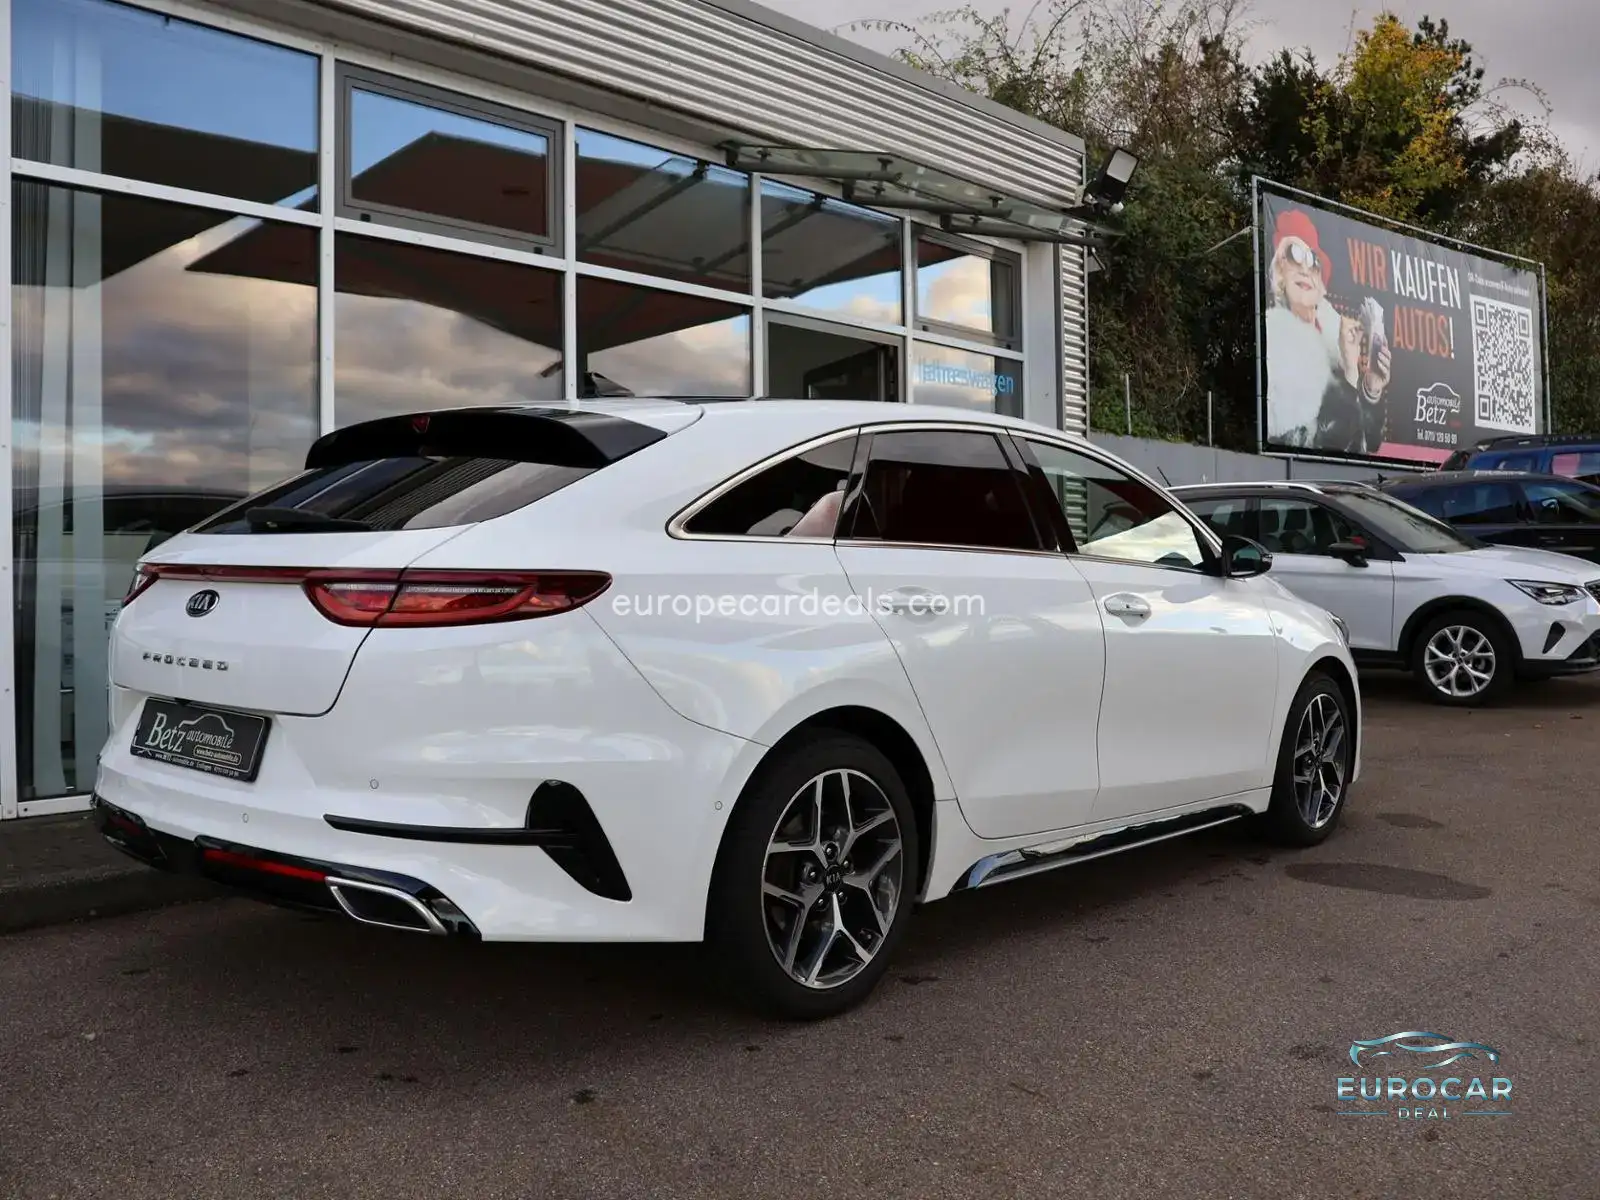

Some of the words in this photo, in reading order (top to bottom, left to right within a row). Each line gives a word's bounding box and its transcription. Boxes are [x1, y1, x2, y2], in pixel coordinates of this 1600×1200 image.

[1346, 237, 1388, 291] WIR
[1391, 250, 1461, 310] KAUFEN
[1393, 303, 1455, 360] AUTOS!
[1414, 395, 1446, 425] Betz
[142, 652, 229, 671] PROCEED
[145, 712, 184, 752] Betz
[825, 871, 841, 884] KIA
